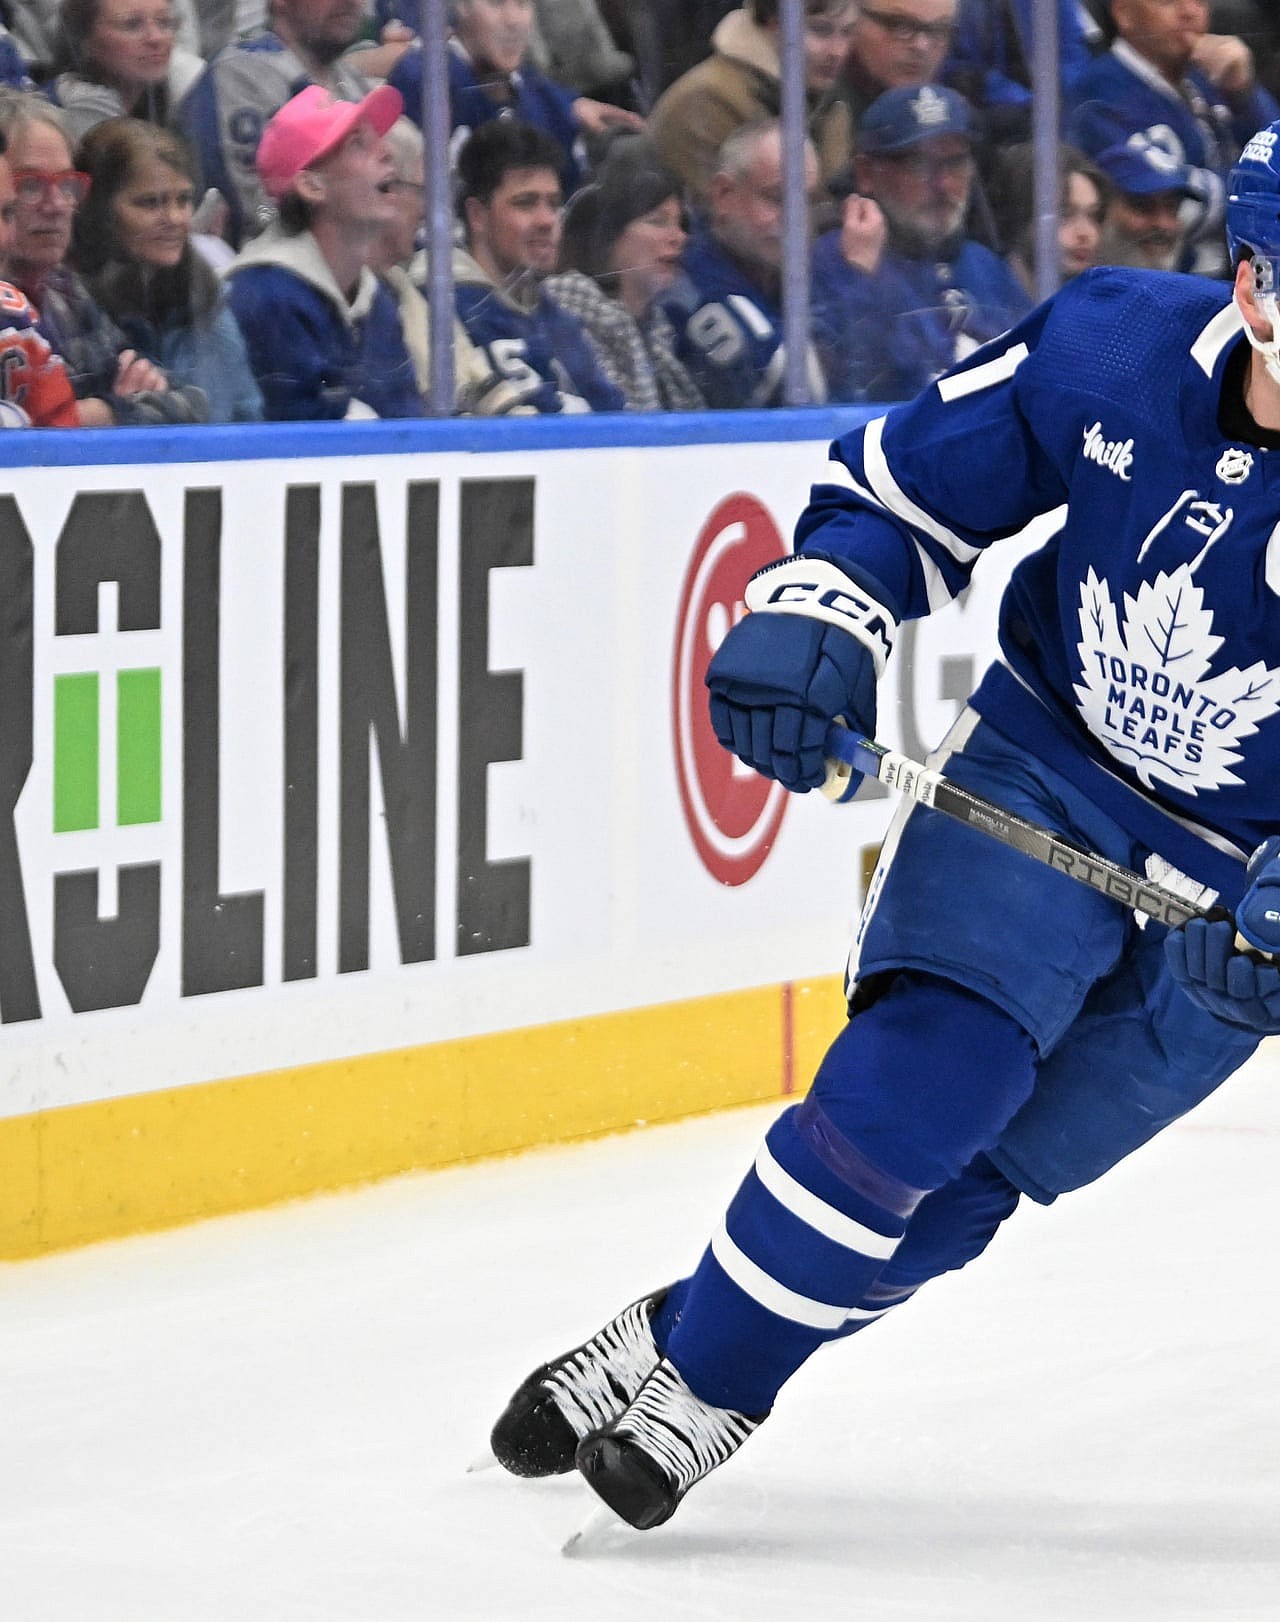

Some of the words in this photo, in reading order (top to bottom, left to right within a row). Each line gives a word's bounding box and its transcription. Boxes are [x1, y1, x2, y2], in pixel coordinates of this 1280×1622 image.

[686, 294, 774, 367] 91
[1093, 650, 1237, 730] TORONTO
[1107, 683, 1207, 742] MAPLE
[1104, 706, 1203, 763] LEAFS
